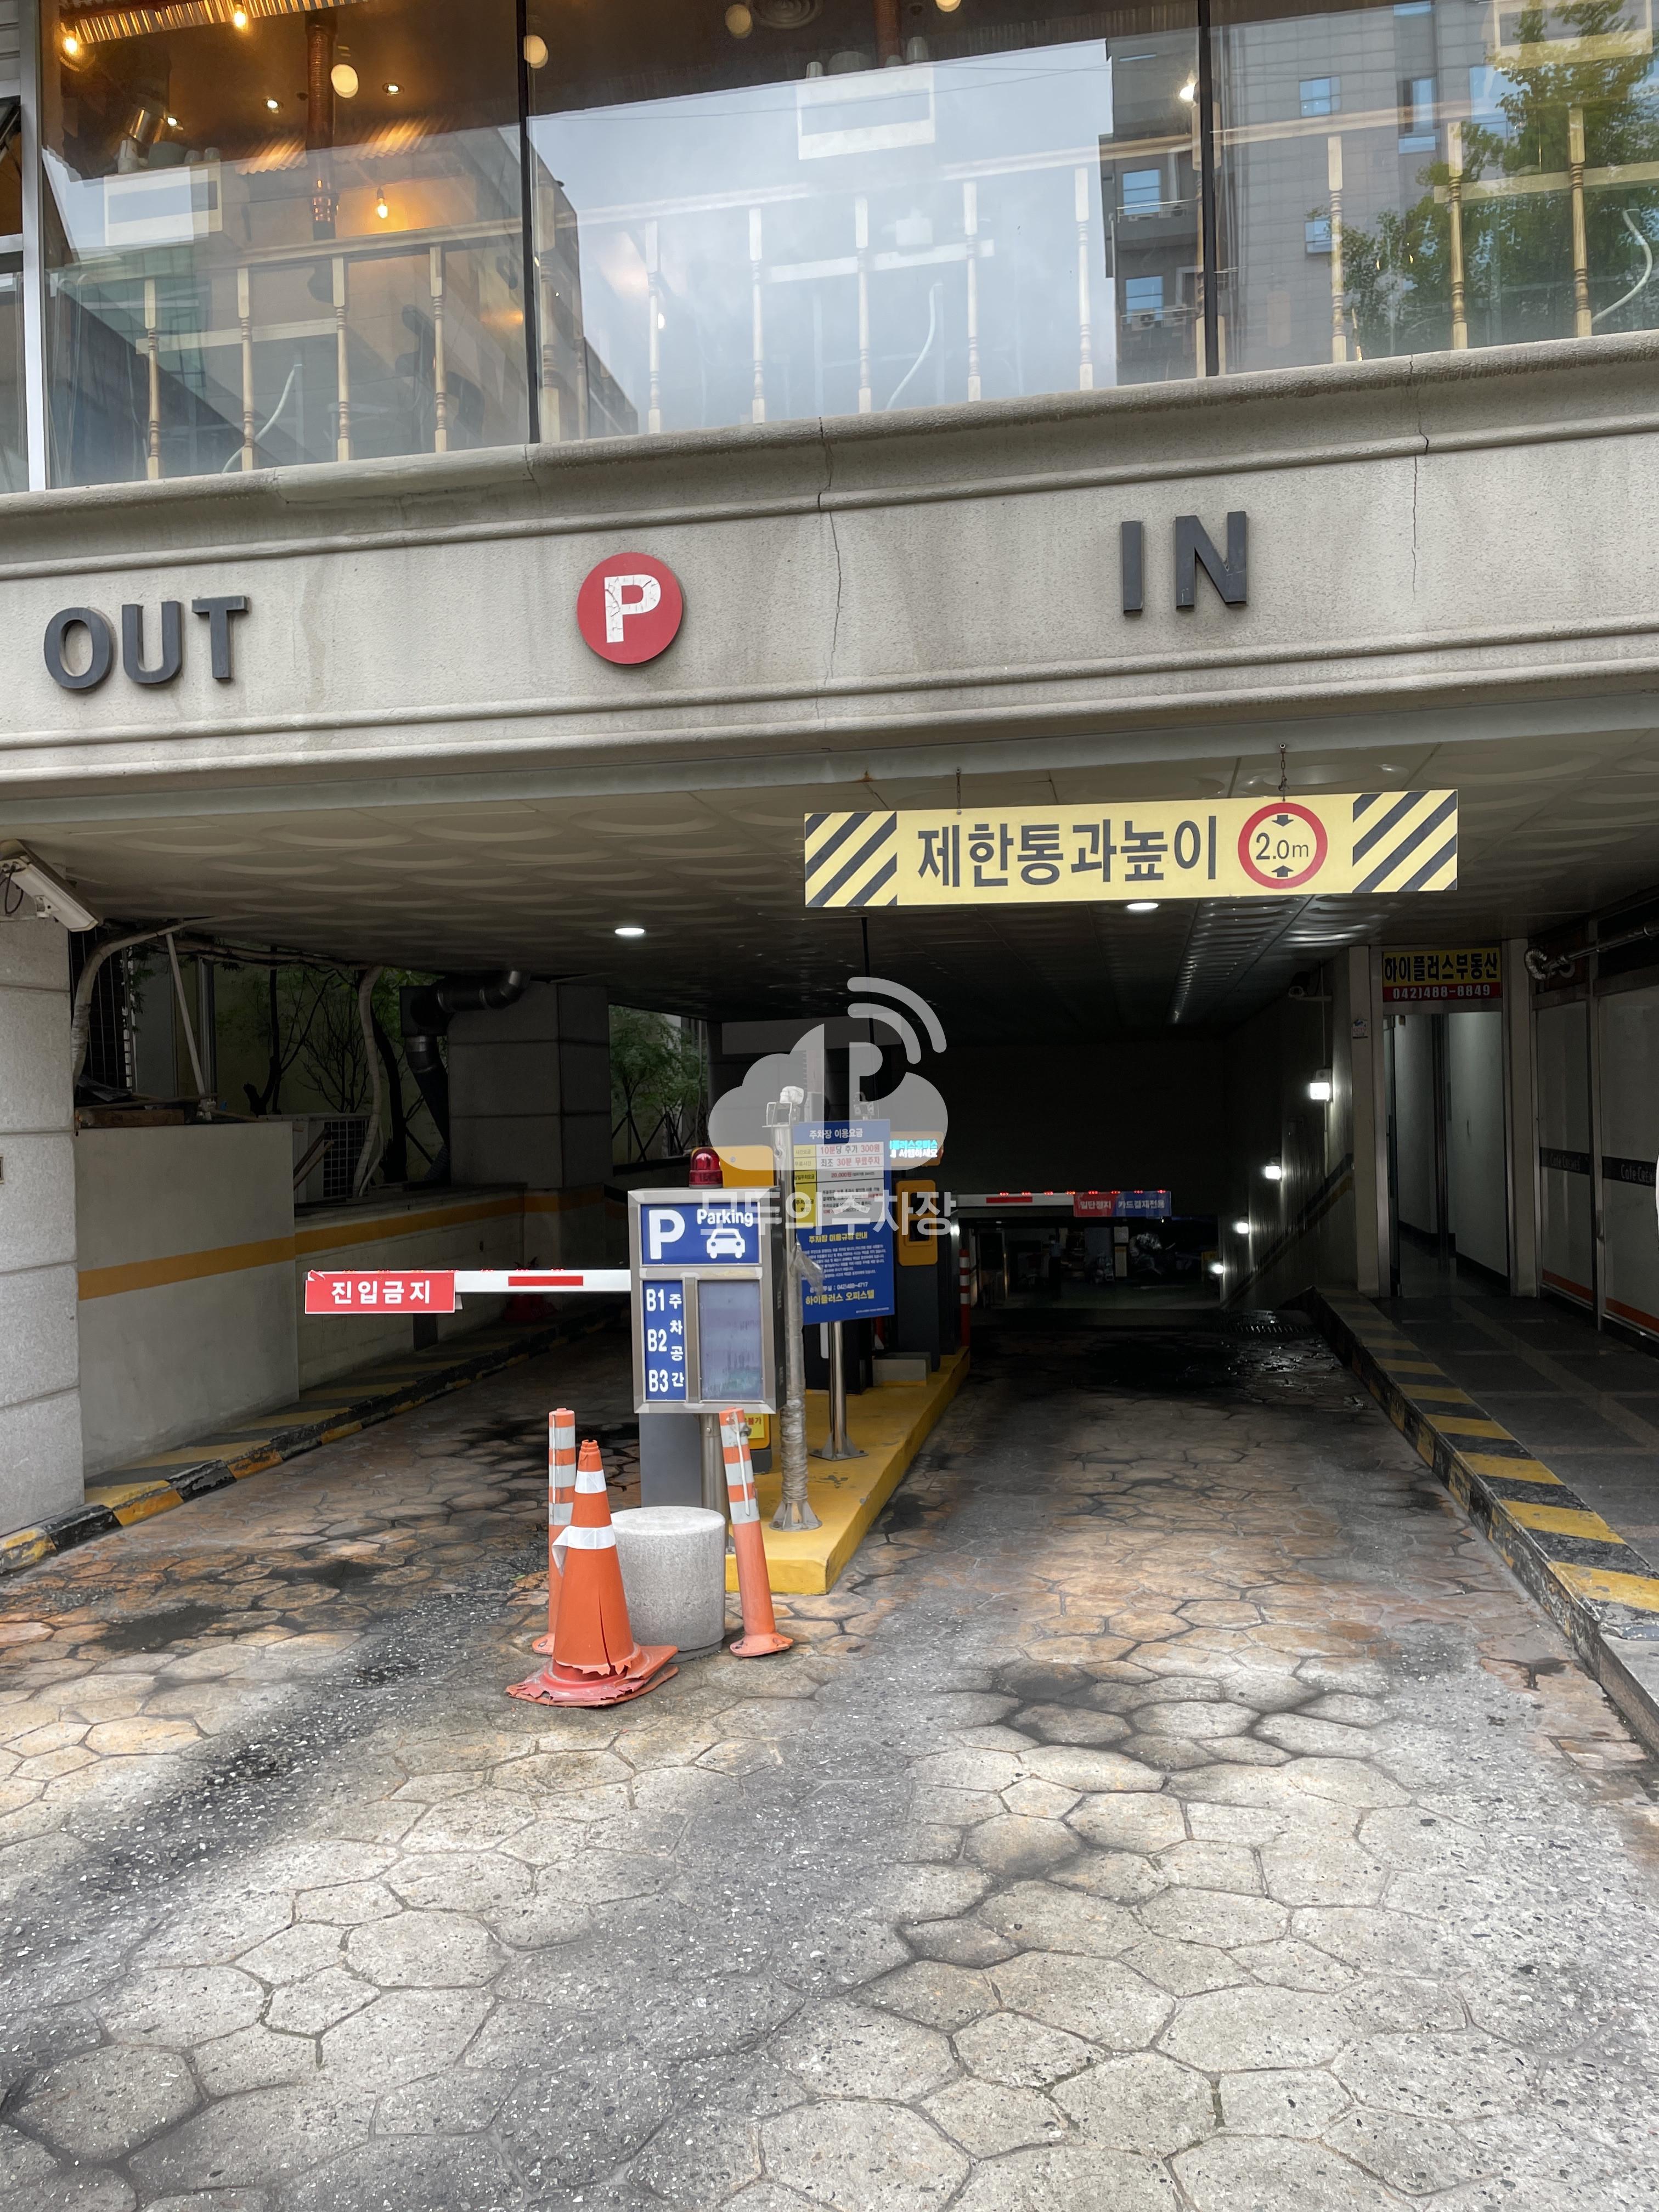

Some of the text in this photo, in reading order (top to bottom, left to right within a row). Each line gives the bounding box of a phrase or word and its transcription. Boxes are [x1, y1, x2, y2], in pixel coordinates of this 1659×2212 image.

[1121, 510, 1248, 613] IN
[604, 573, 662, 644] P
[43, 595, 249, 690] OUT
[917, 815, 1217, 887] 제한통과높이
[1255, 831, 1310, 860] 2.0m
[1384, 952, 1498, 983] 하이플러스부동산
[1393, 984, 1491, 1000] 042)488-8849
[809, 1128, 864, 1139] 주차장 이용요금
[820, 1144, 880, 1155] 10분당 추가 300원
[821, 1158, 834, 1167] 최초
[837, 1158, 852, 1166] 30분
[648, 1209, 754, 1260] P Parking
[331, 1280, 431, 1305] 진입금지
[646, 1288, 665, 1312] B1
[805, 1289, 875, 1306] 하이플러스 오피스텔
[647, 1329, 668, 1352] B2
[648, 1369, 669, 1393] B3
